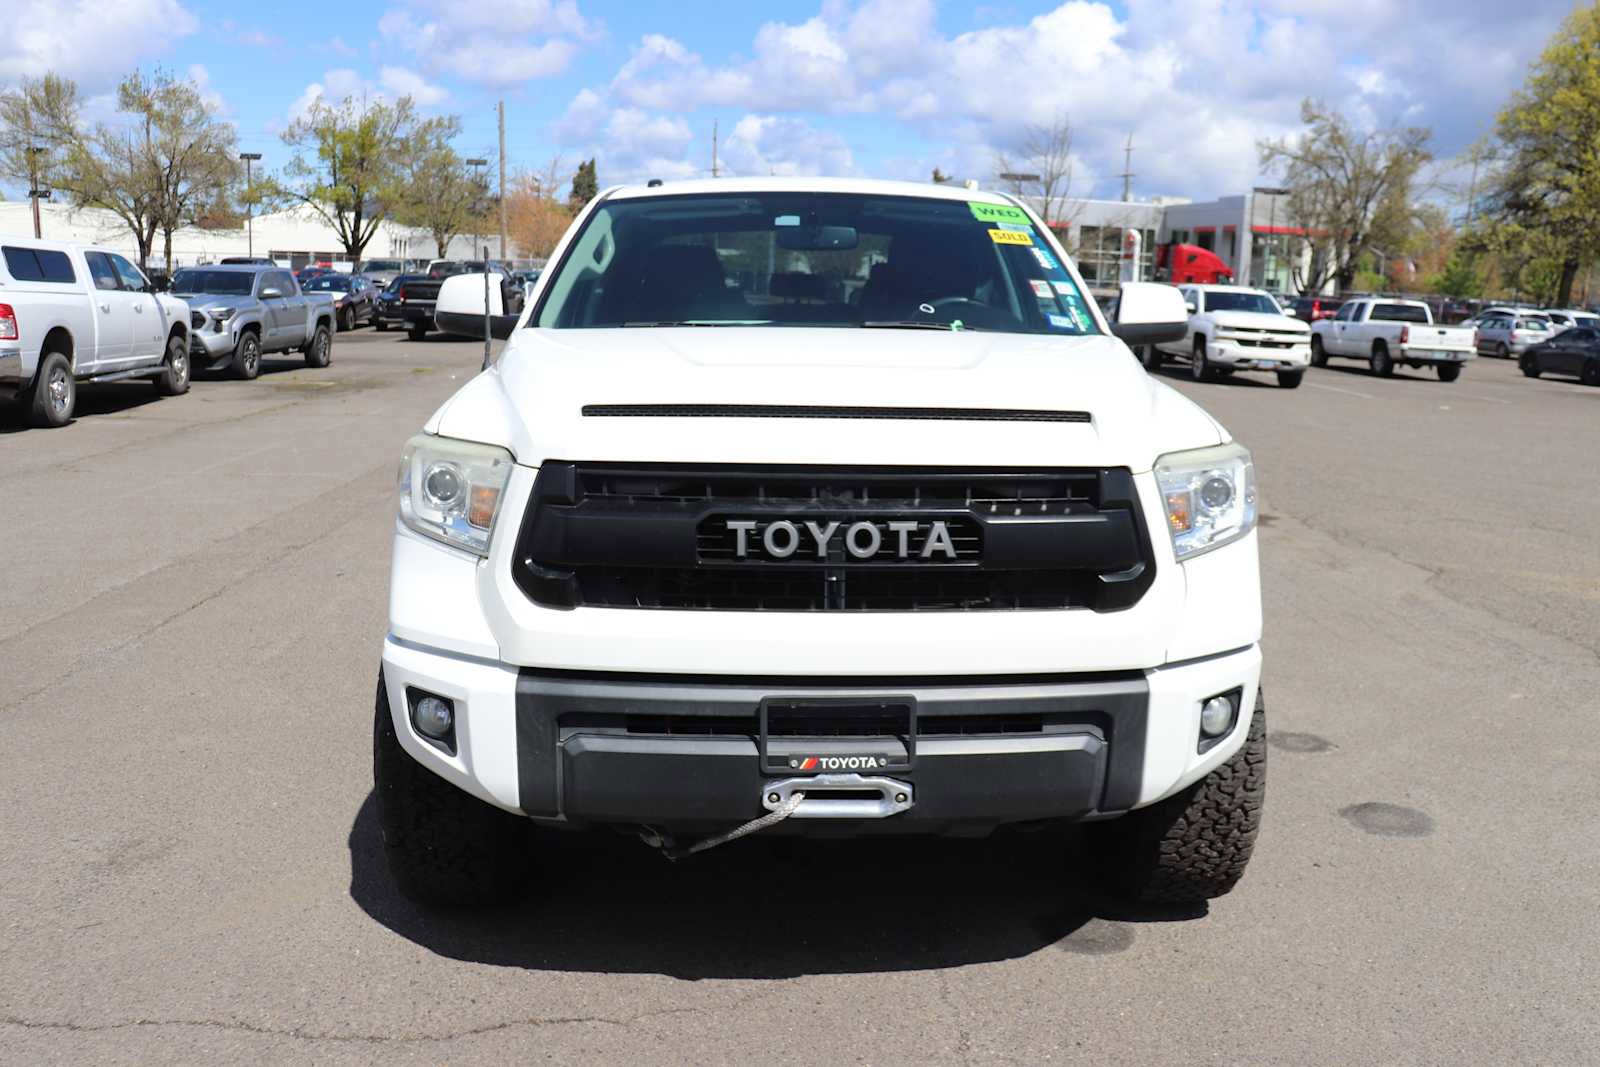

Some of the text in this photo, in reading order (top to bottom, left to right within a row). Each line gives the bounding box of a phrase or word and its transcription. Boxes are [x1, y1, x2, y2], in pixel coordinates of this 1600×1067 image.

[977, 207, 1020, 218] WED
[993, 231, 1029, 242] SOLD
[726, 520, 957, 558] TOYOTA
[819, 757, 878, 769] TOYOTA
